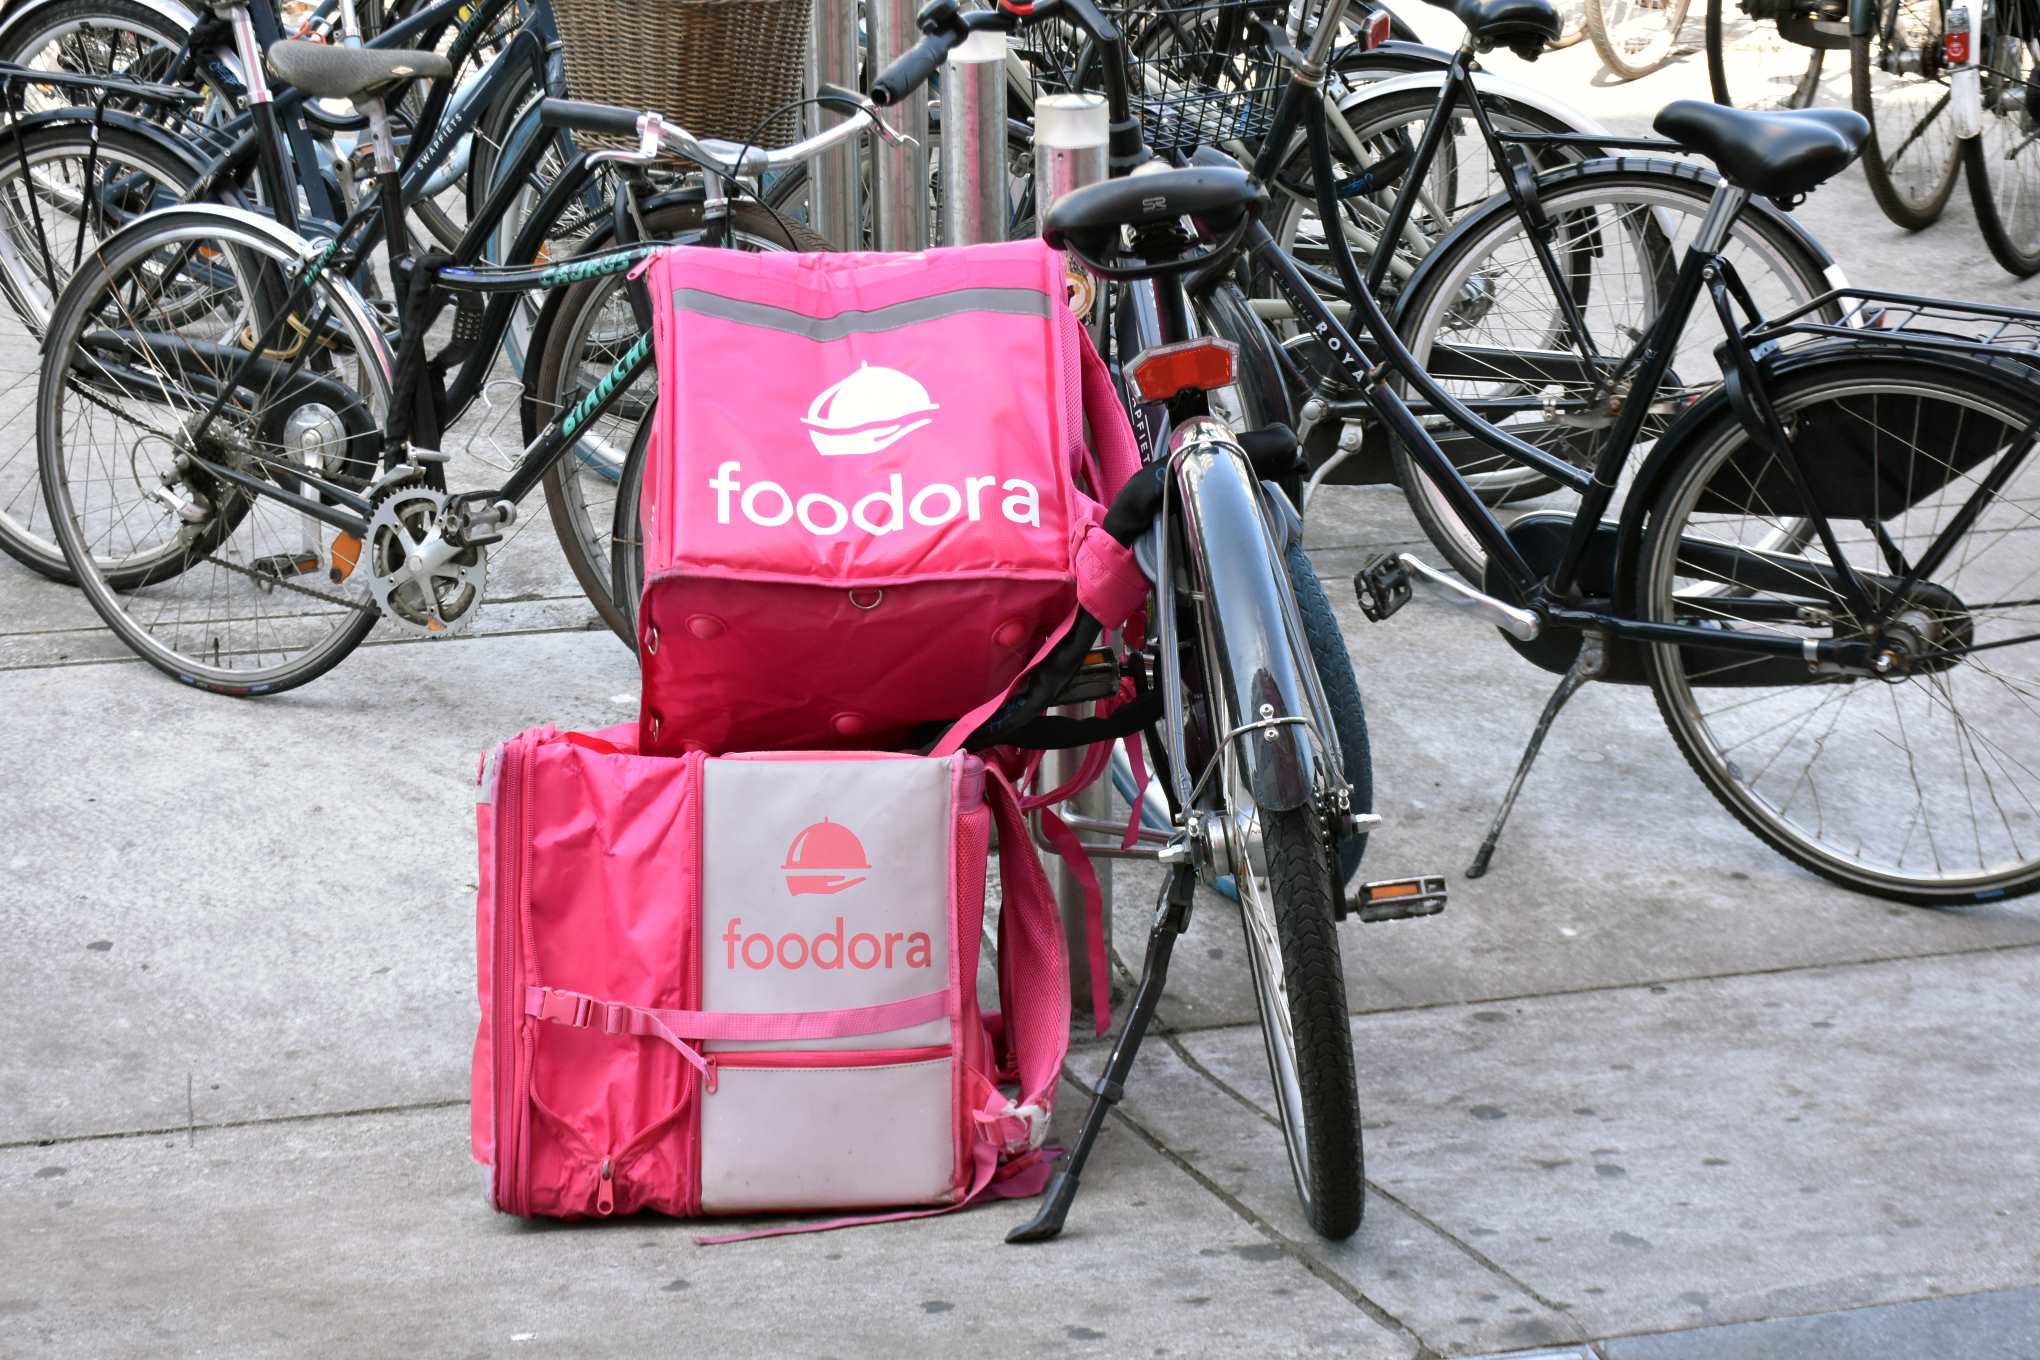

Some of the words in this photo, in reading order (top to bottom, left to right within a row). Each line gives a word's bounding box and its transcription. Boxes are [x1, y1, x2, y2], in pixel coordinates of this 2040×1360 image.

[416, 113, 463, 170] SWAPFIETS
[562, 334, 648, 437] BIANCHI
[1315, 321, 1375, 395] ROYAL
[708, 460, 1041, 536] foodora
[722, 916, 932, 970] foodora
